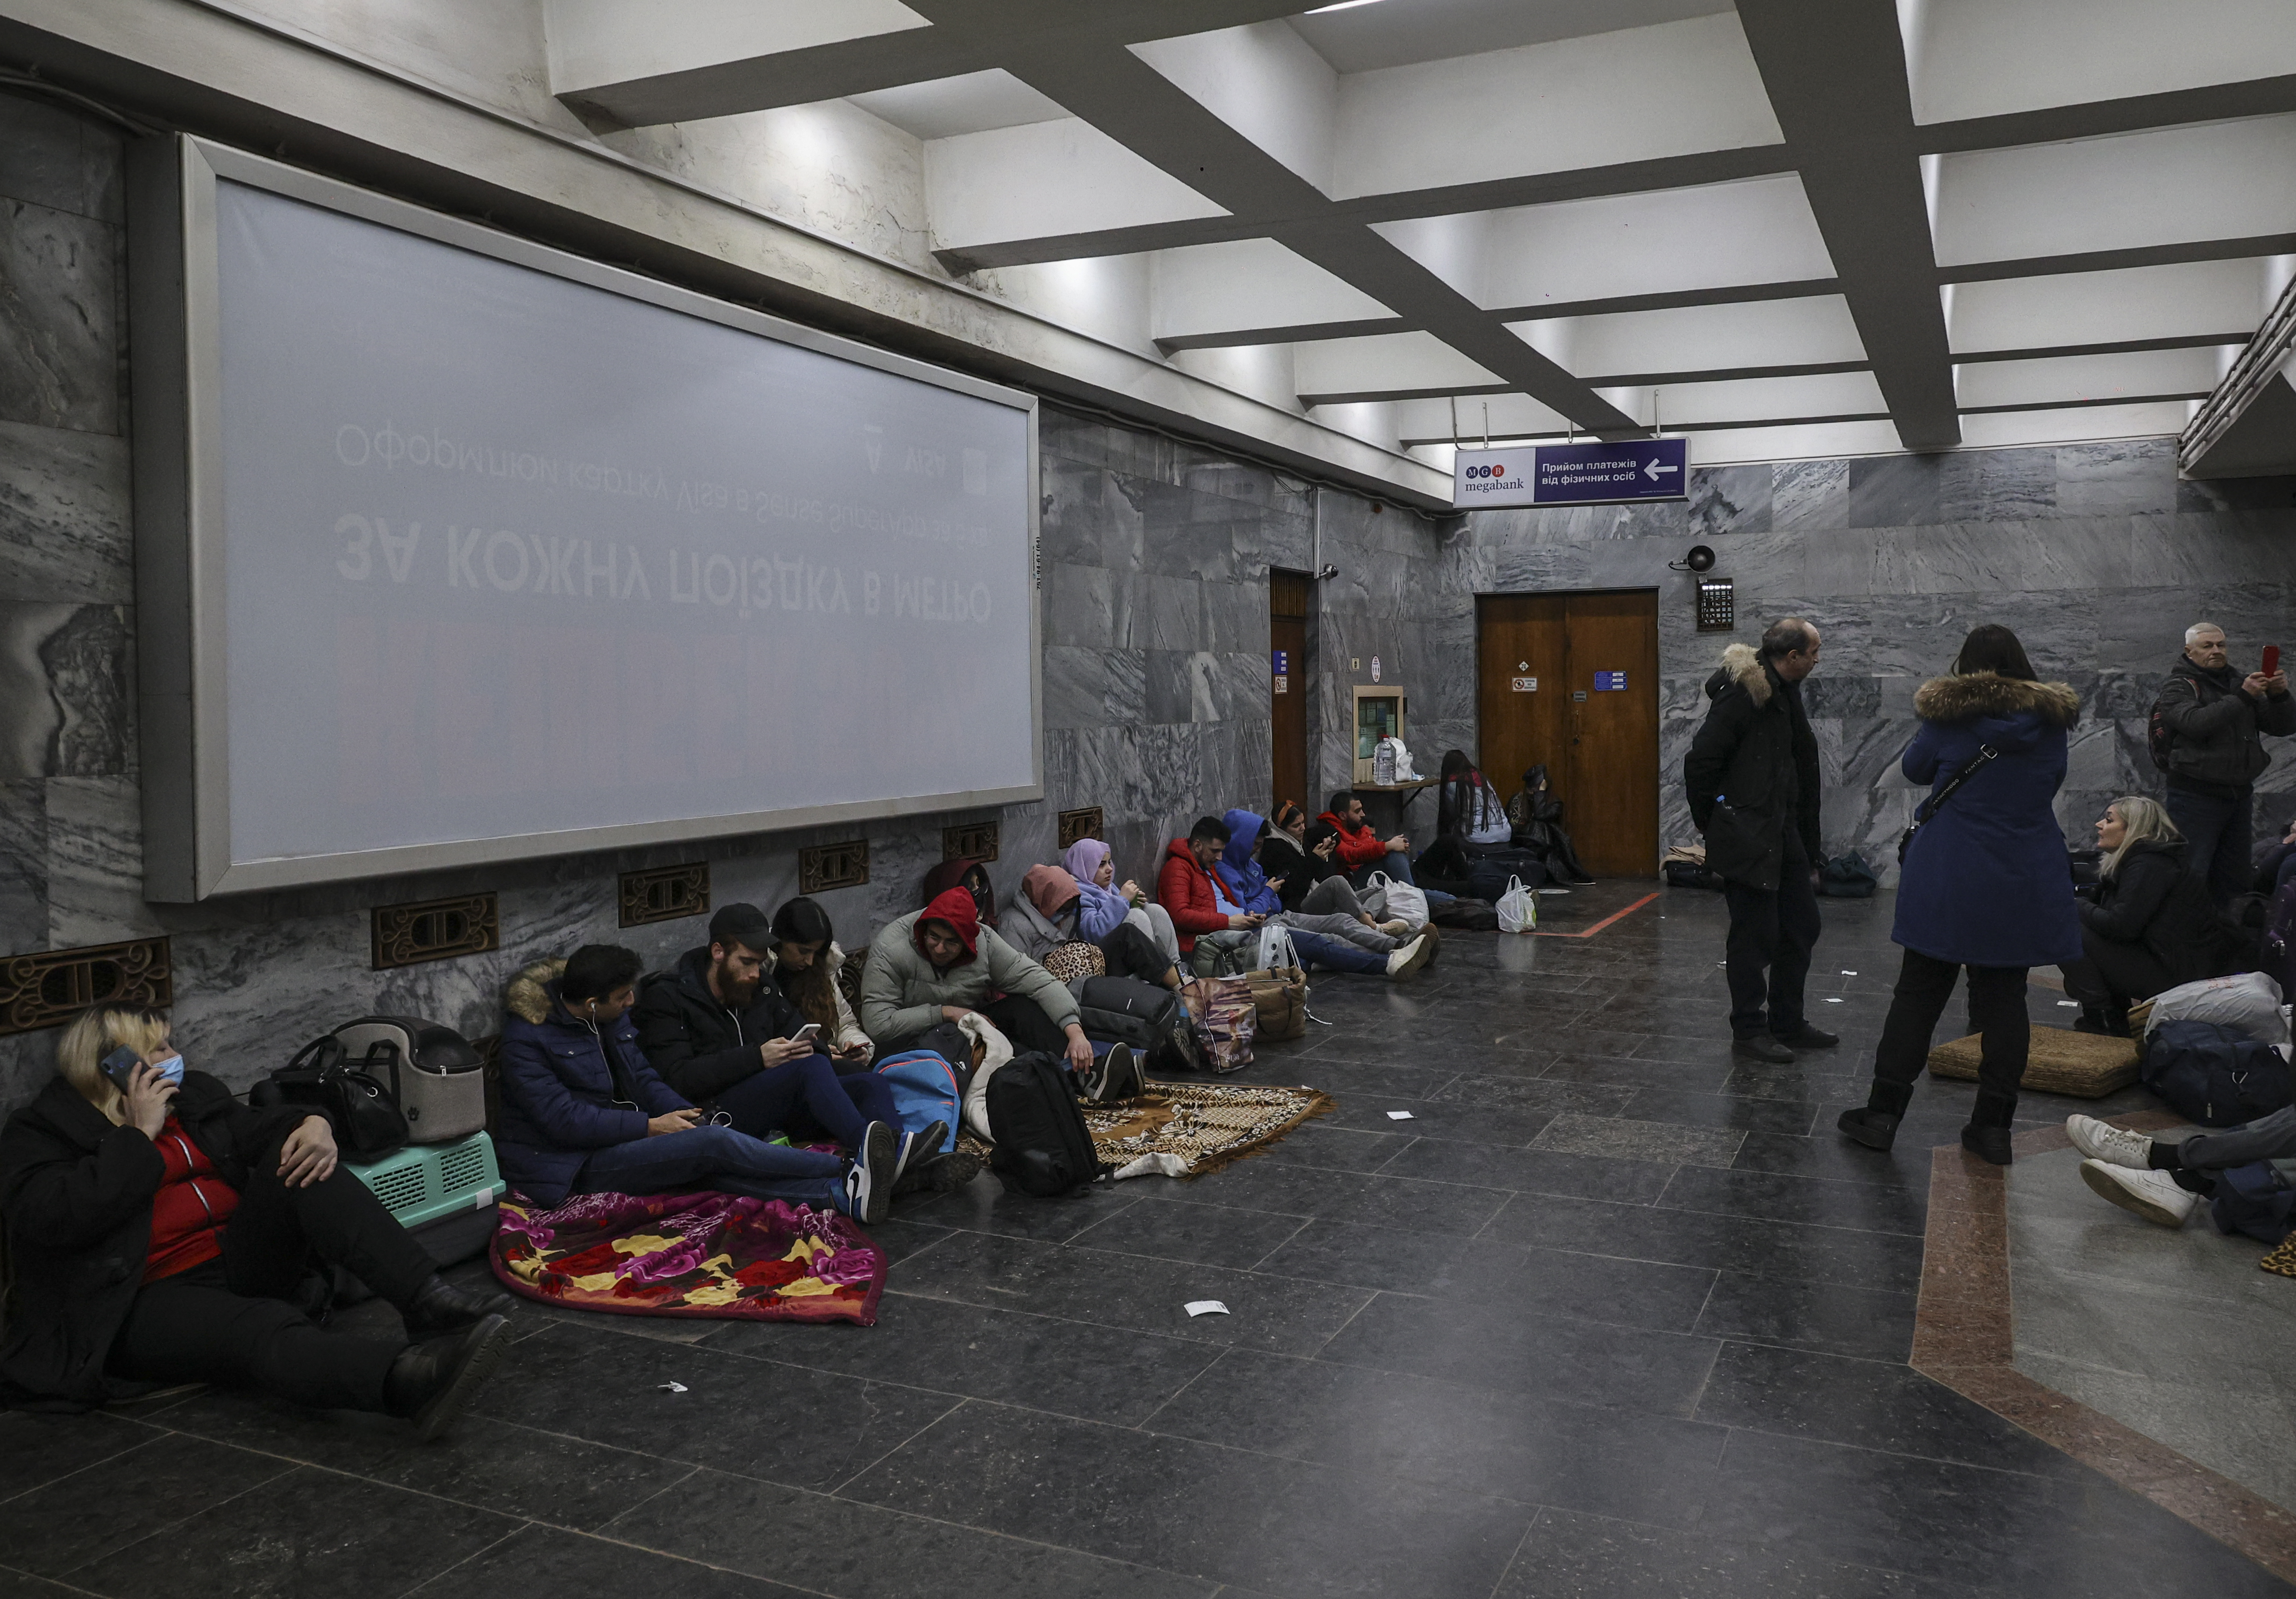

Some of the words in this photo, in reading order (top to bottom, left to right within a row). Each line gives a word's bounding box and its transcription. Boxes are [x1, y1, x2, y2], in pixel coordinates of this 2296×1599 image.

[1542, 462, 1583, 474] Прийом
[1586, 459, 1637, 470] платежів
[1465, 478, 1524, 493] megabank
[1542, 475, 1558, 485] від
[1561, 474, 1610, 485] фізичних
[1612, 471, 1636, 481] осіб
